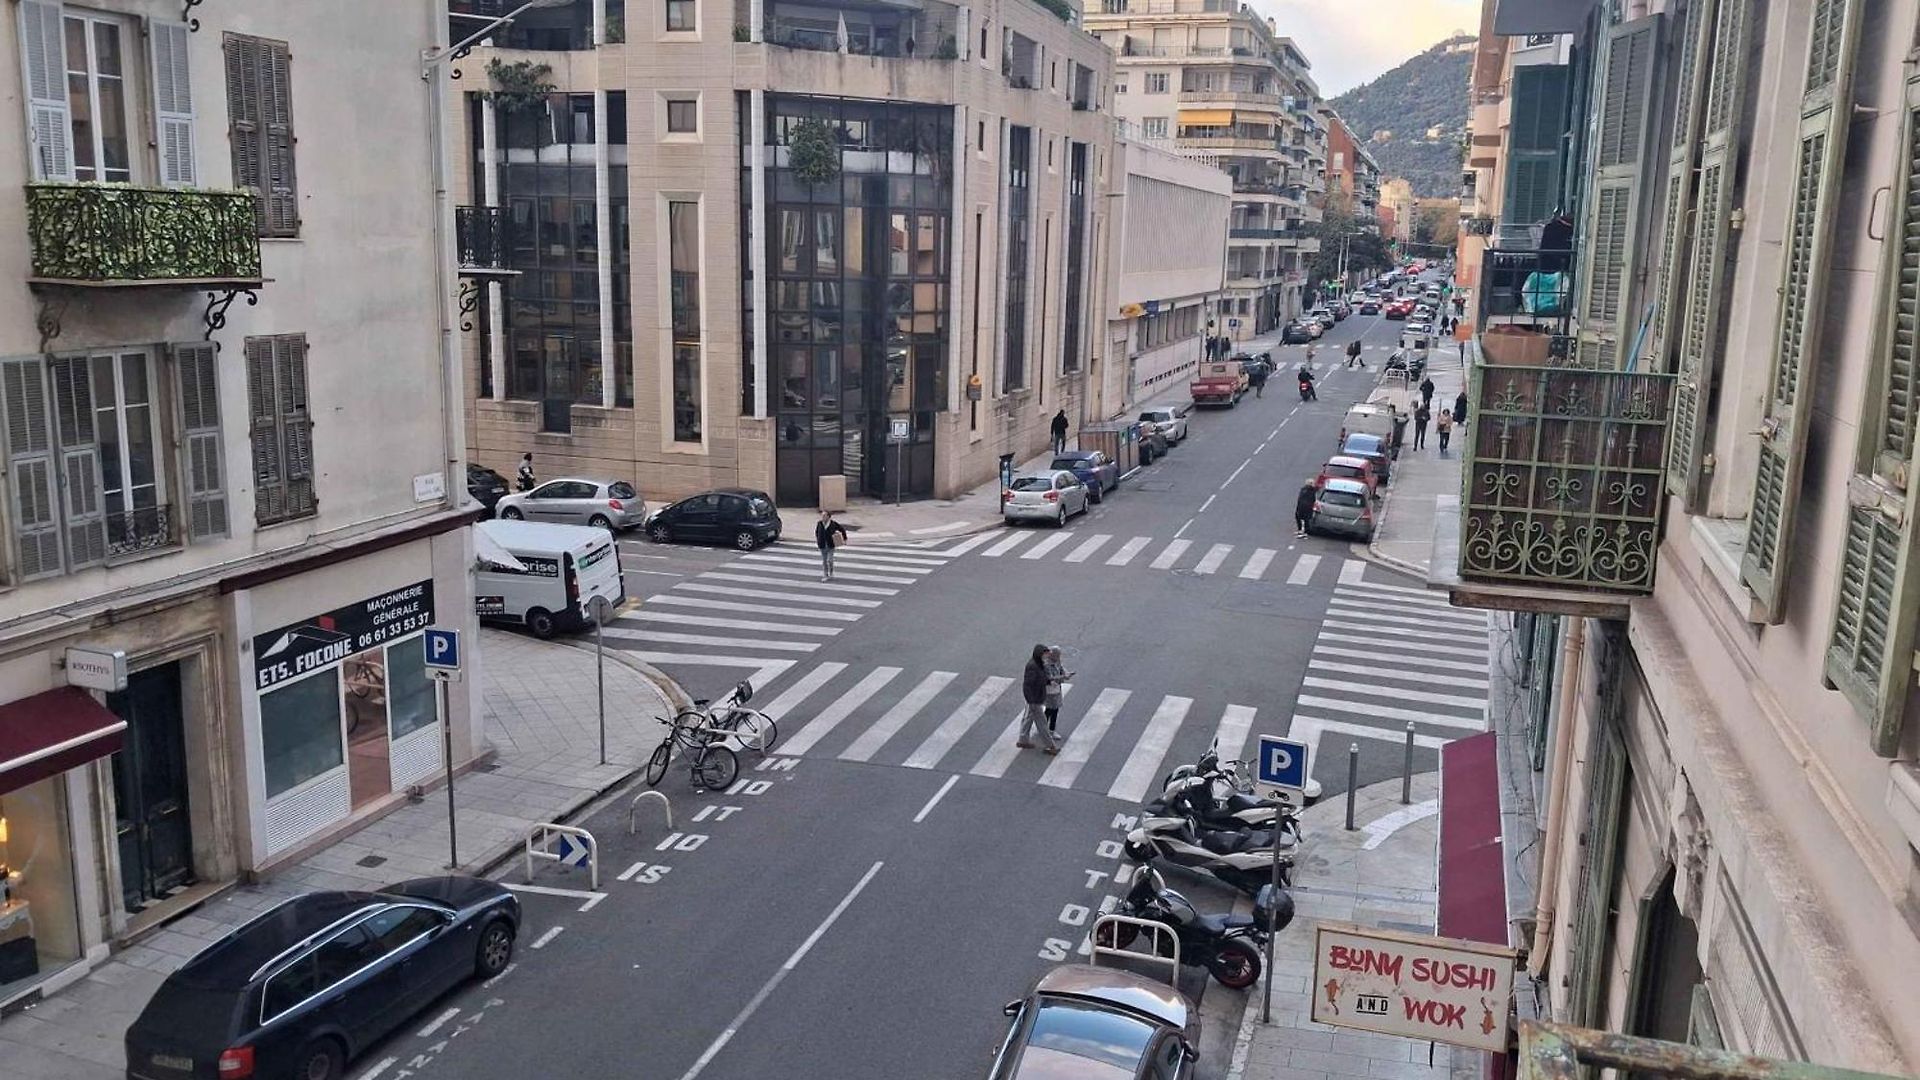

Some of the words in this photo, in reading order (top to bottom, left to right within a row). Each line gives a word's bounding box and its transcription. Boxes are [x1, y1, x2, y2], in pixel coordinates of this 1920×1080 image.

[367, 585, 423, 612] MAÇONNERIE
[359, 633, 372, 647] 06
[374, 628, 386, 643] 61
[389, 622, 402, 637] 33
[403, 617, 416, 631] 53
[418, 612, 430, 626] 37
[259, 662, 293, 687] ETS.
[296, 638, 352, 673] FOCONE
[433, 635, 449, 659] P
[1271, 748, 1292, 775] P
[1038, 813, 1138, 961] MOTOS
[1412, 958, 1496, 991] SUSHI
[1356, 997, 1389, 1012] AND
[1403, 997, 1467, 1030] WOK
